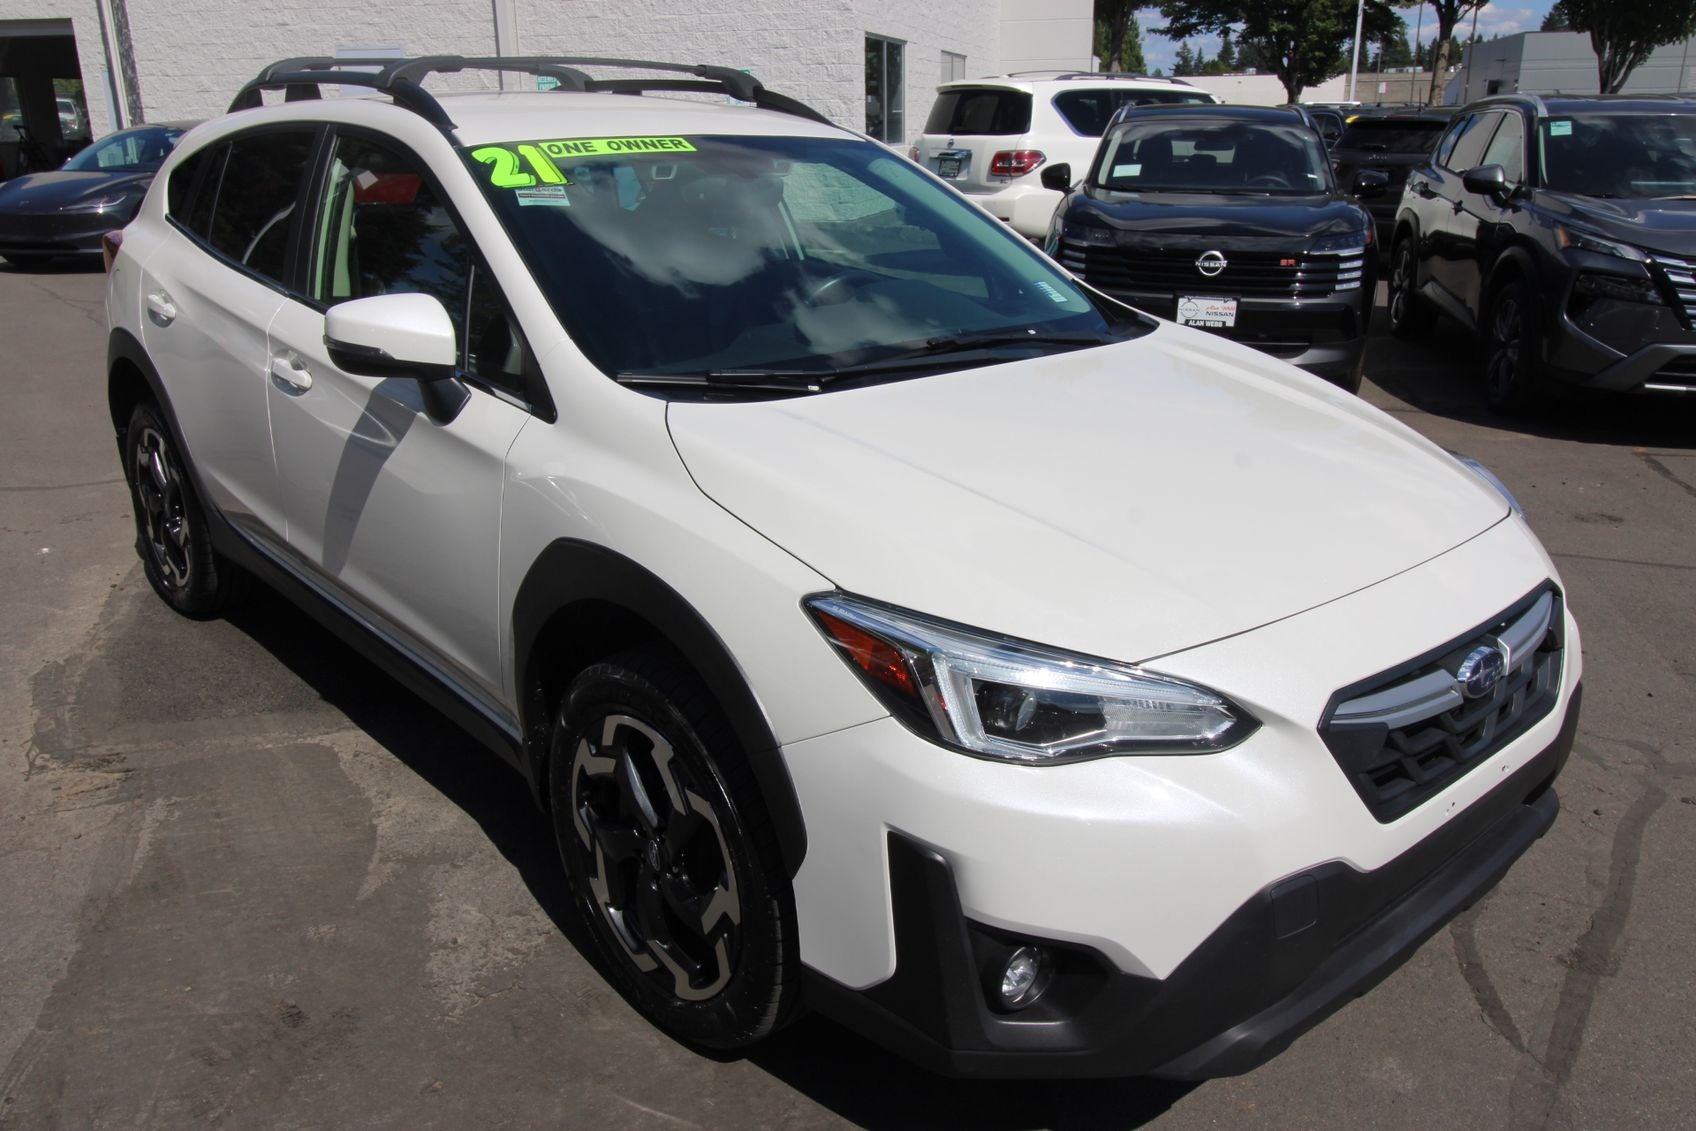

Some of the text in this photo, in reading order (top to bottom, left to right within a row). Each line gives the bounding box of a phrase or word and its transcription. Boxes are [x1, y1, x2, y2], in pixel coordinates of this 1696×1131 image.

[548, 138, 685, 155] ONE OWNER
[472, 145, 568, 187] 21
[1195, 260, 1228, 268] NISSAN
[1189, 319, 1204, 327] ALAN
